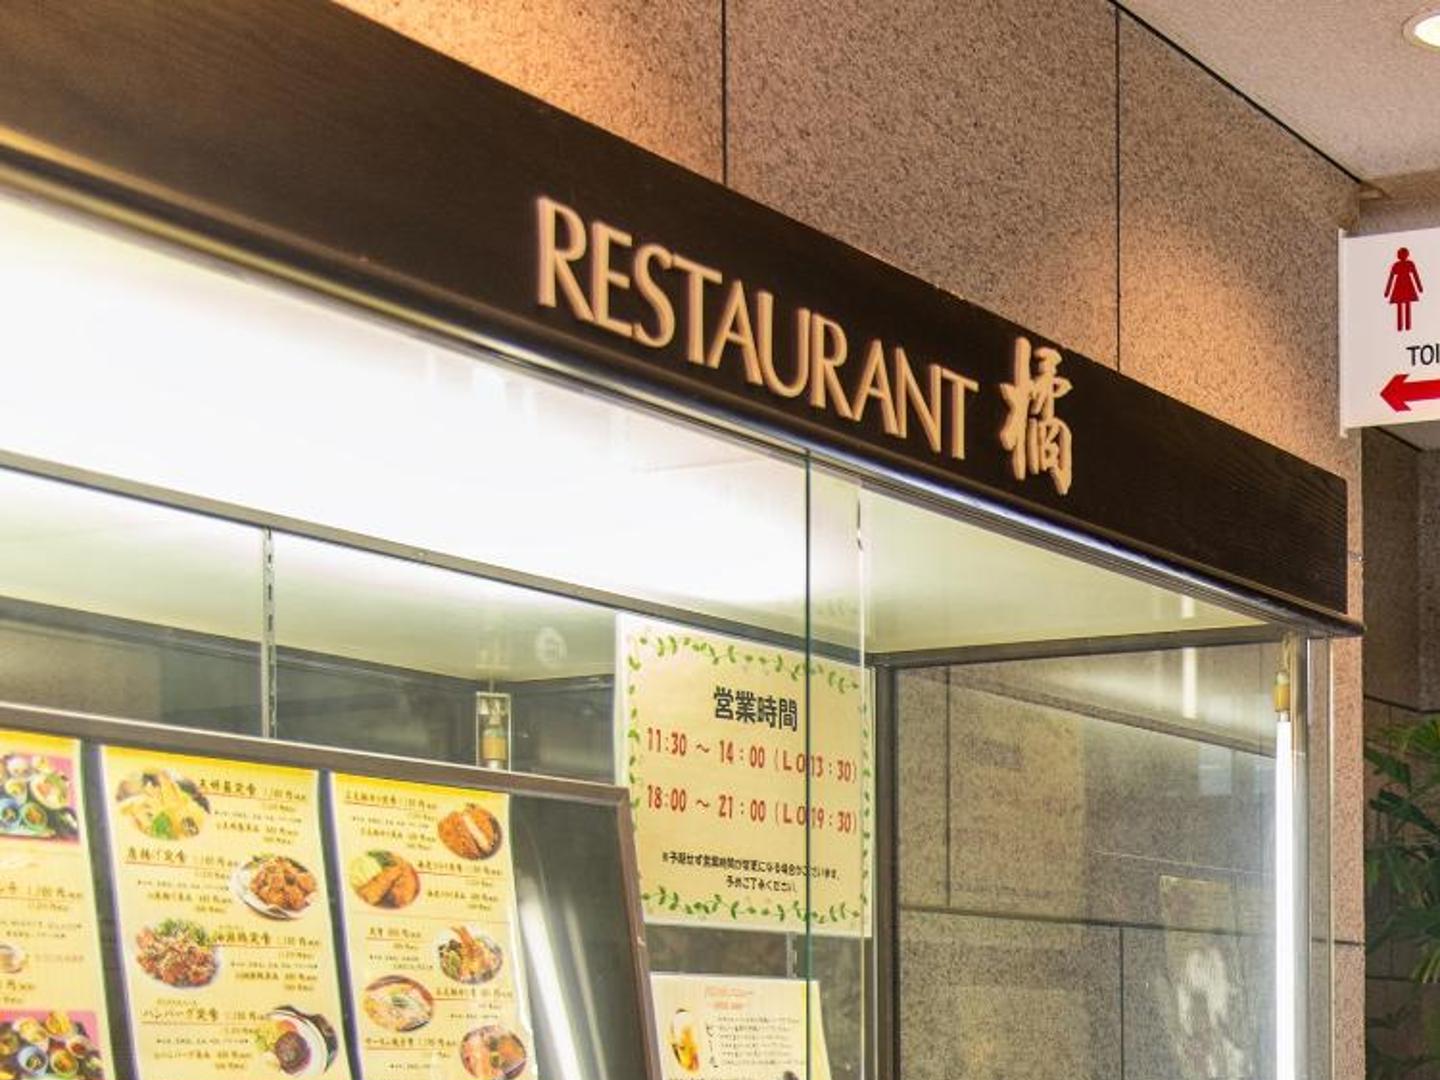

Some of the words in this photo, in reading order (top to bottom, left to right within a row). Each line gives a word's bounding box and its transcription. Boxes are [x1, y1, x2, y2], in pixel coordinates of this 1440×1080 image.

[538, 196, 979, 459] RESTAURANT
[1001, 337, 1072, 495] 橘
[713, 686, 797, 732] 営業時間
